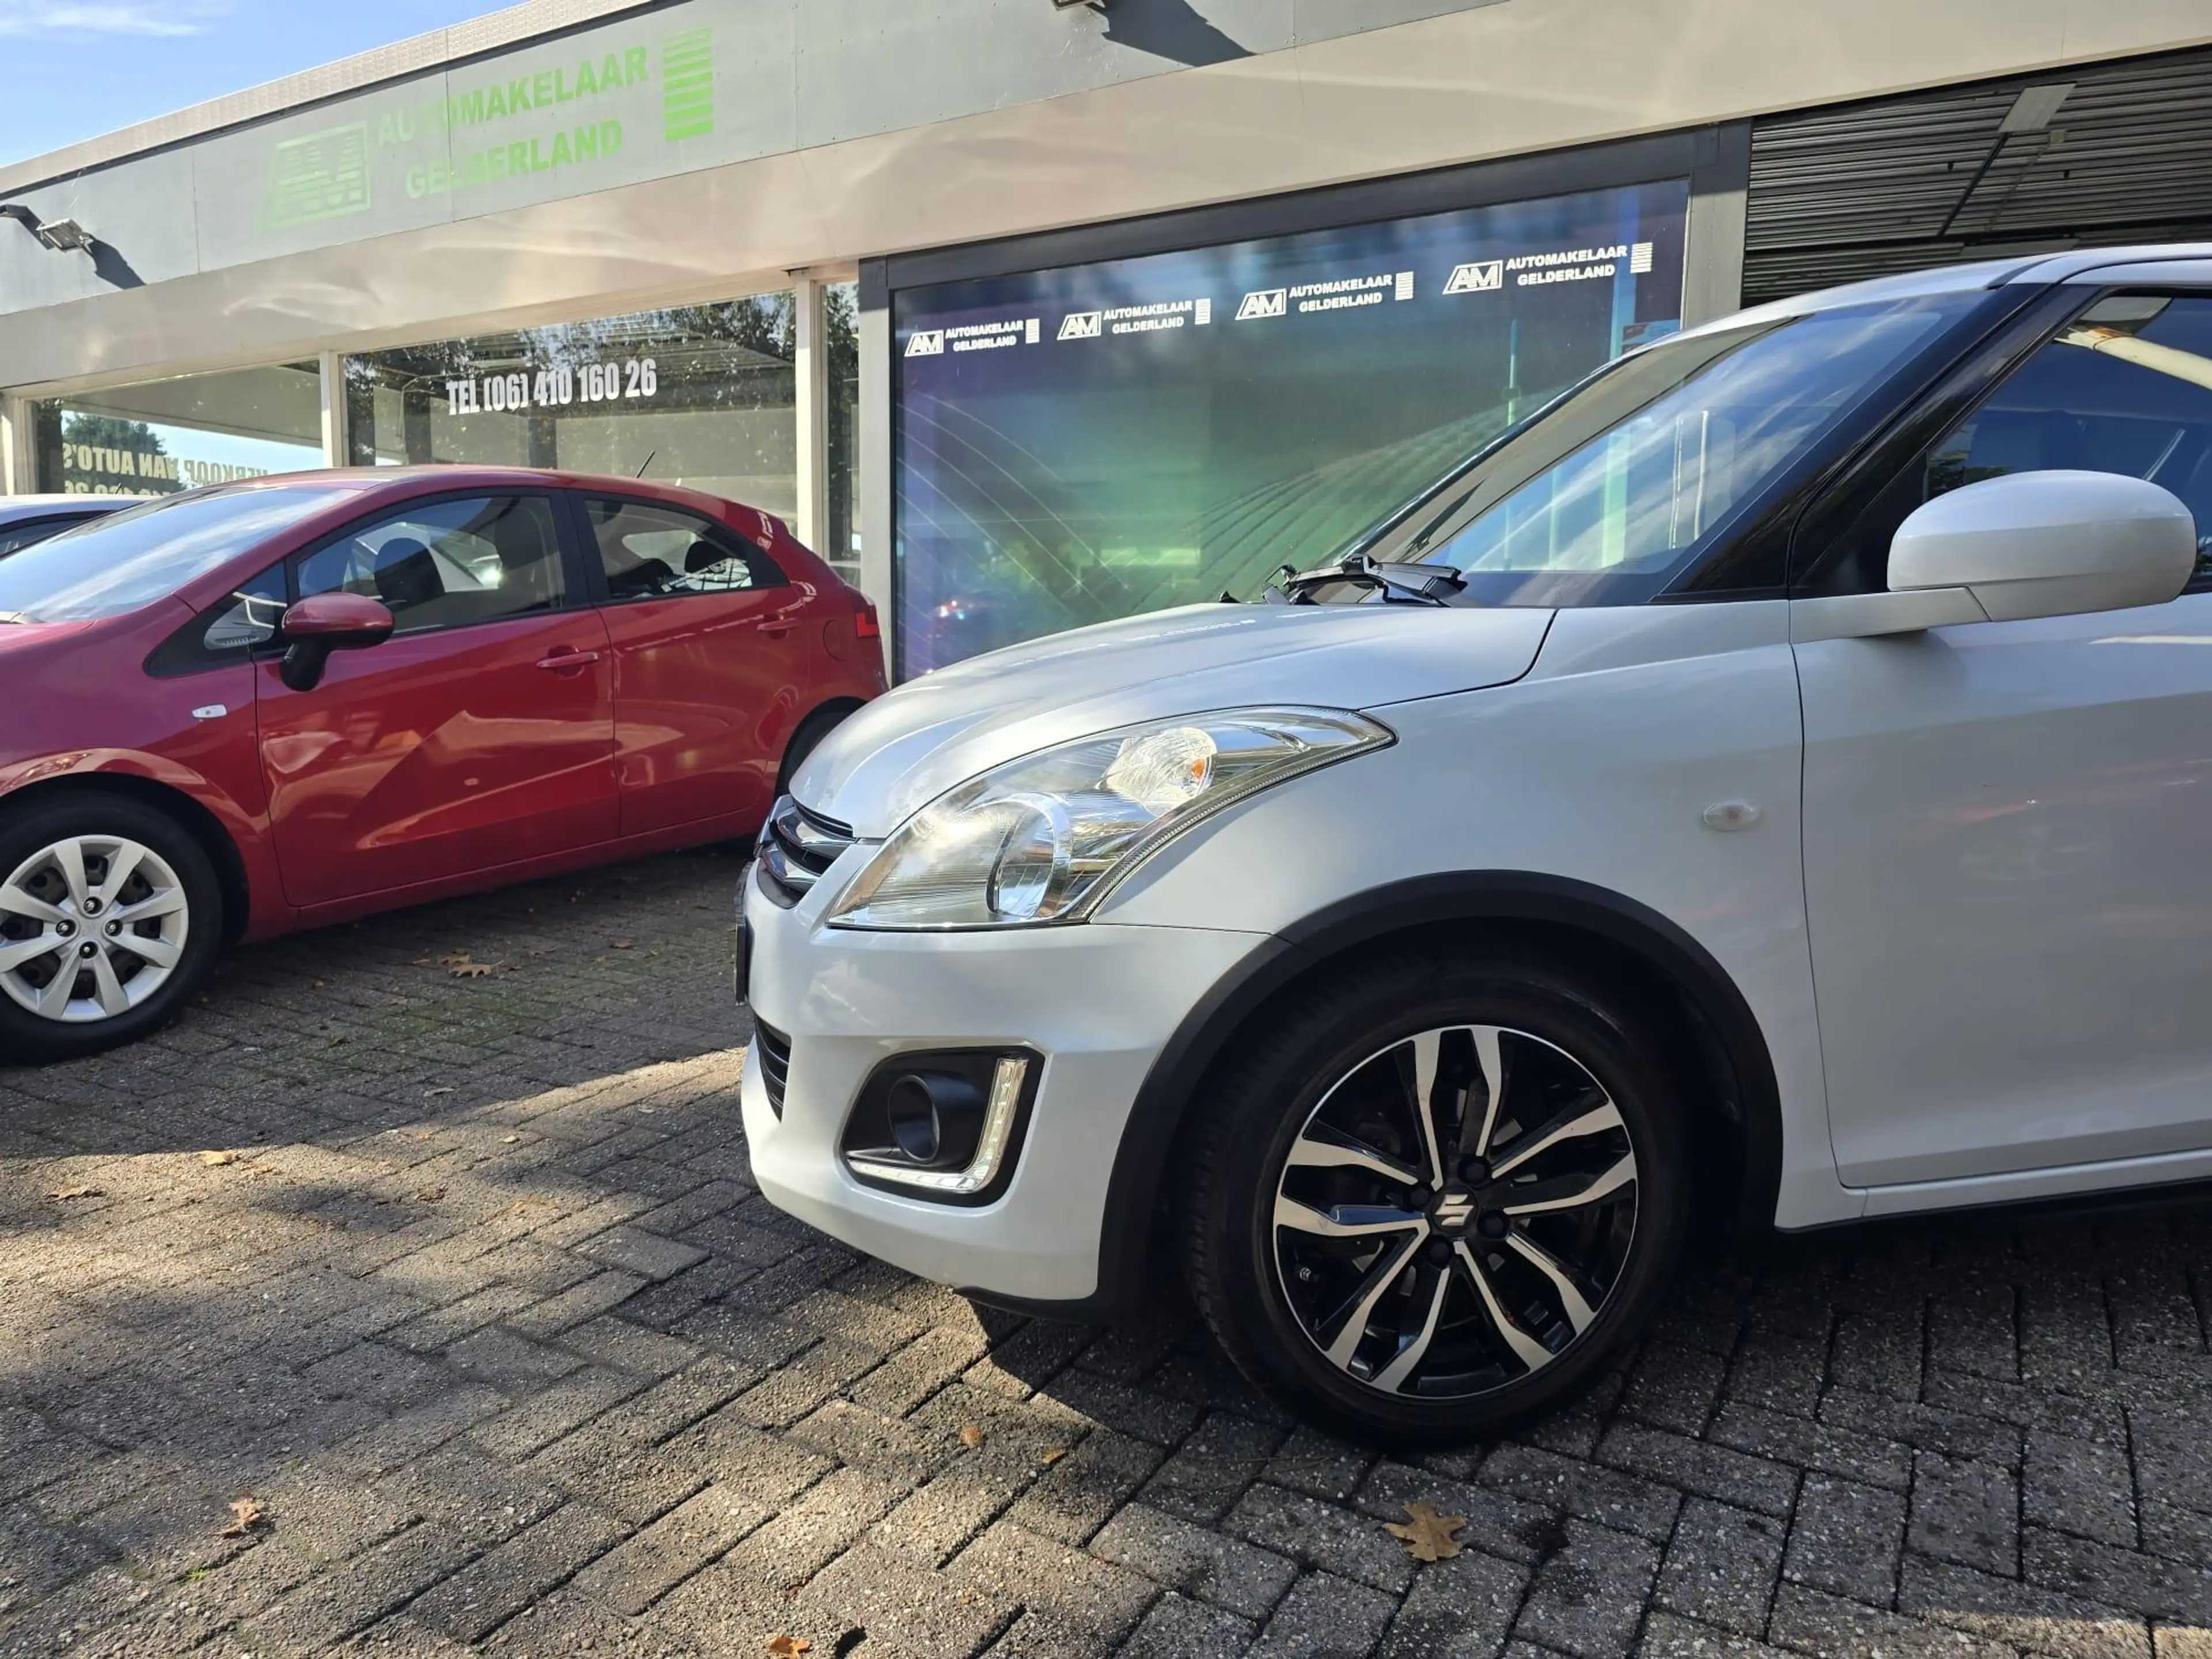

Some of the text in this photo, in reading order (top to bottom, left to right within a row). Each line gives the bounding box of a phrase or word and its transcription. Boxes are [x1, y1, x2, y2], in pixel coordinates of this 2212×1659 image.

[377, 46, 649, 145] AUTOMAKELAAR
[406, 120, 623, 198] GELDERLAND
[1506, 245, 1627, 270] AUTOMAKELAAR
[1289, 274, 1392, 298] AUTOMAKELAAR
[1449, 264, 1498, 291] AM
[1517, 264, 1615, 286] GELDERLAND
[1104, 301, 1192, 320] AUTOMAKELAAR
[1240, 292, 1283, 317] AM
[1299, 292, 1382, 312] GELDERLAND
[945, 320, 1024, 339] AUTOMAKELAAR
[1060, 314, 1099, 338] AM
[1112, 317, 1184, 334] GELDERLAND
[907, 334, 941, 354] AM
[953, 335, 1017, 352] GELDERLAND
[446, 358, 657, 416] TEL (06) 410 160 26
